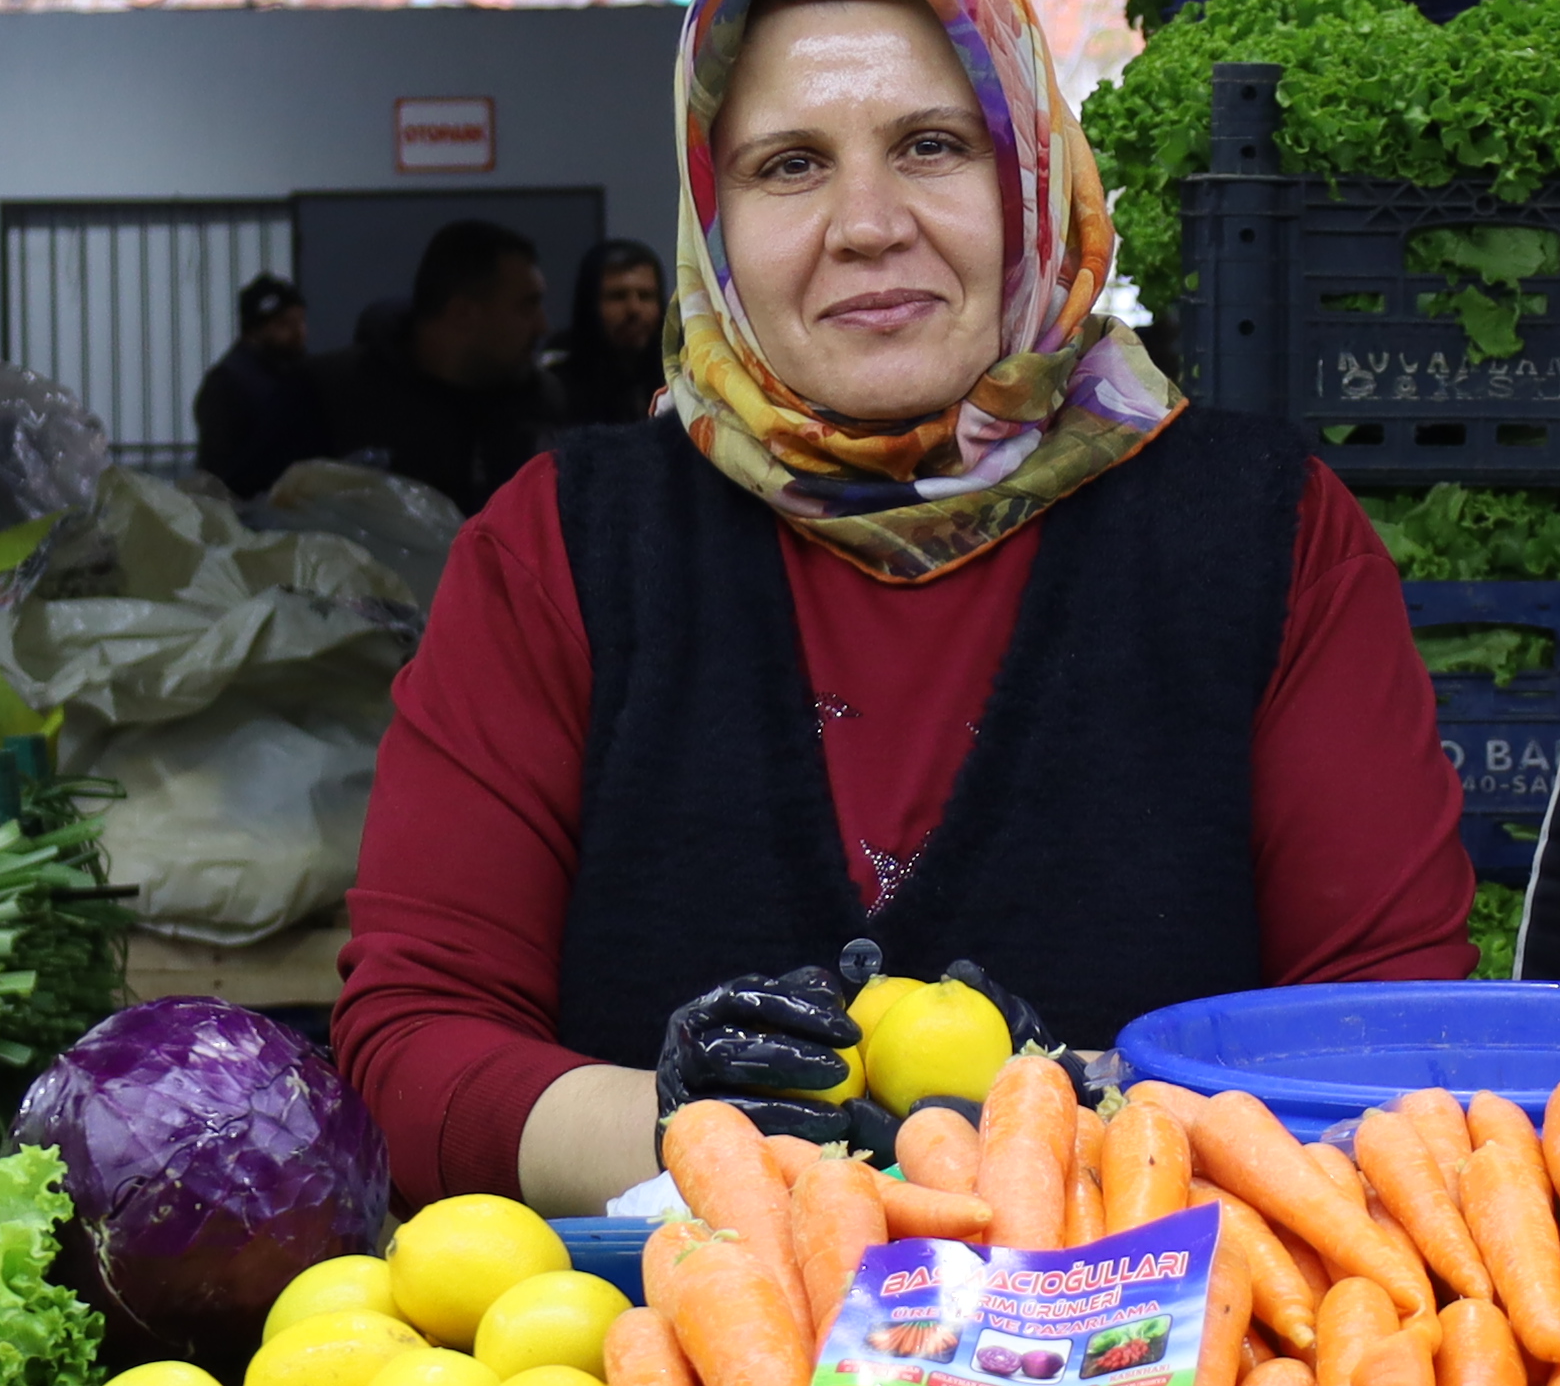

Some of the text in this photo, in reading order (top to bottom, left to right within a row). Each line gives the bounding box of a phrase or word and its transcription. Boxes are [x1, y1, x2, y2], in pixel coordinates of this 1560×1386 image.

[1463, 775, 1558, 794] 40-SA
[988, 1314, 1020, 1333] VE
[1023, 1300, 1161, 1336] PAZARLAMA
